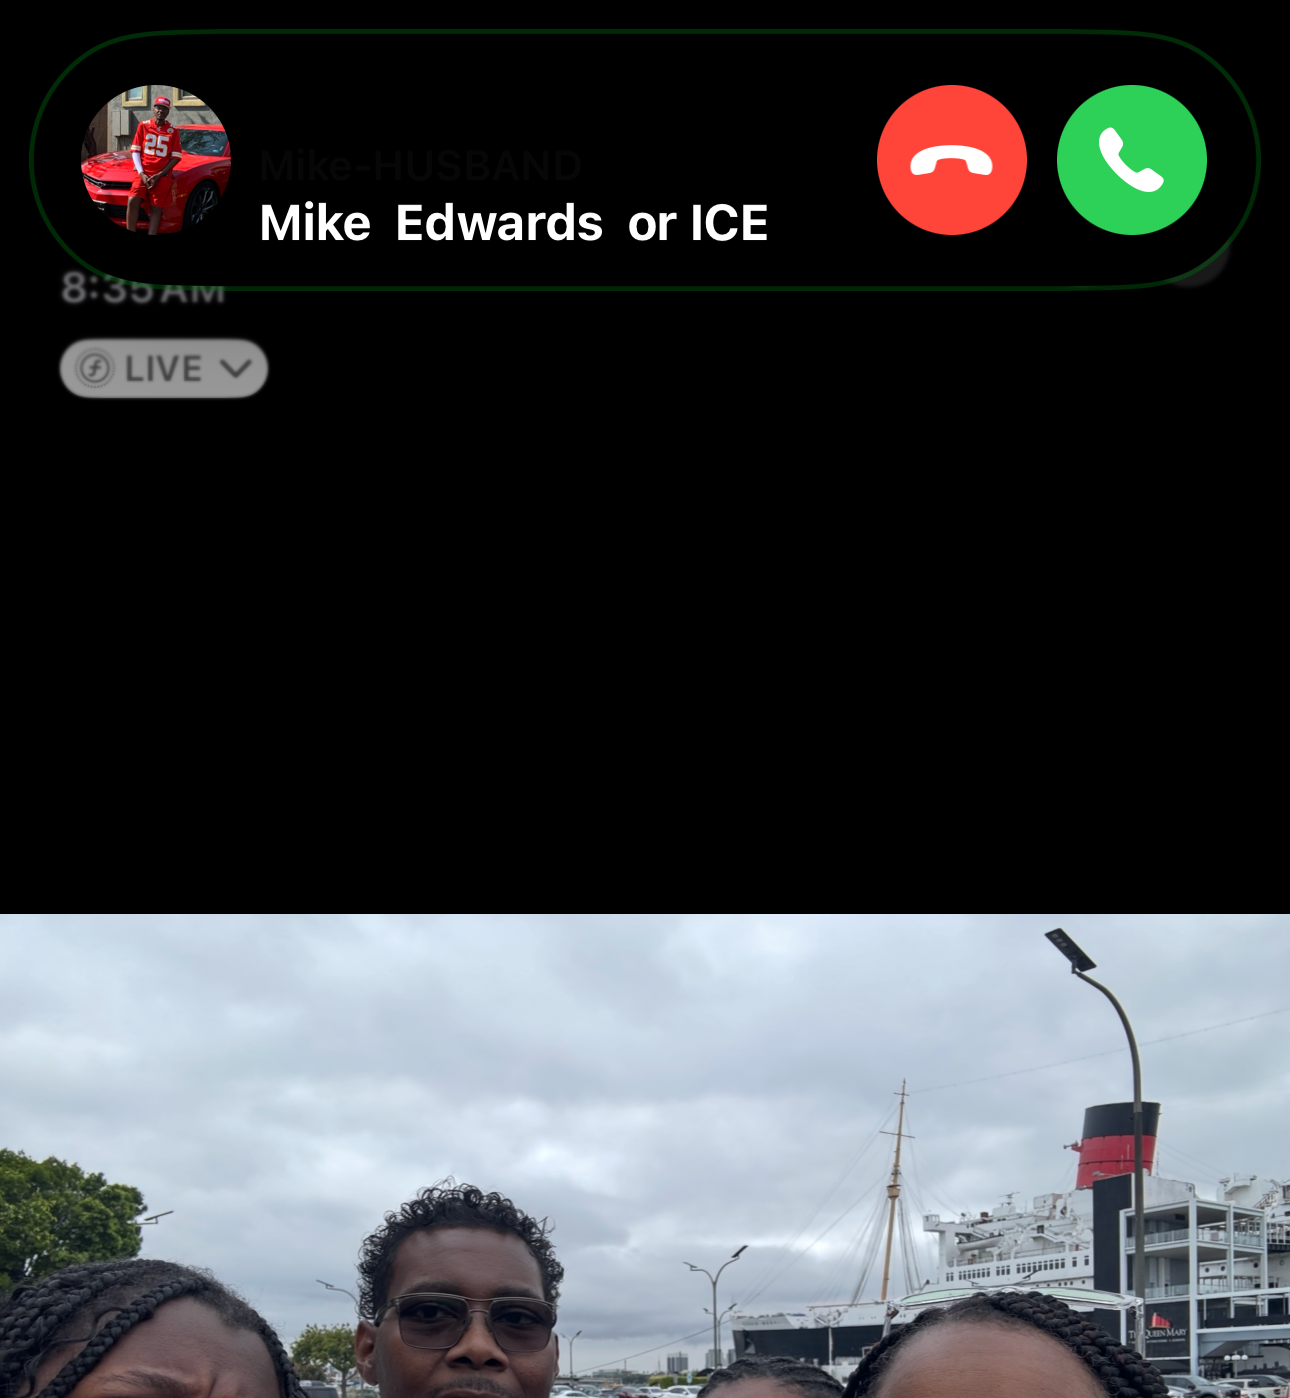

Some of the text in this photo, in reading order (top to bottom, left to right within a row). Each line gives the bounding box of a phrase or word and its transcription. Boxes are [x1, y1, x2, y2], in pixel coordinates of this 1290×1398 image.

[144, 133, 170, 157] 25
[261, 147, 582, 182] Mike-HUSBAND
[261, 201, 768, 242] Mike Edwards or ICE
[62, 270, 154, 304] 8:35
[126, 354, 202, 382] LIVE
